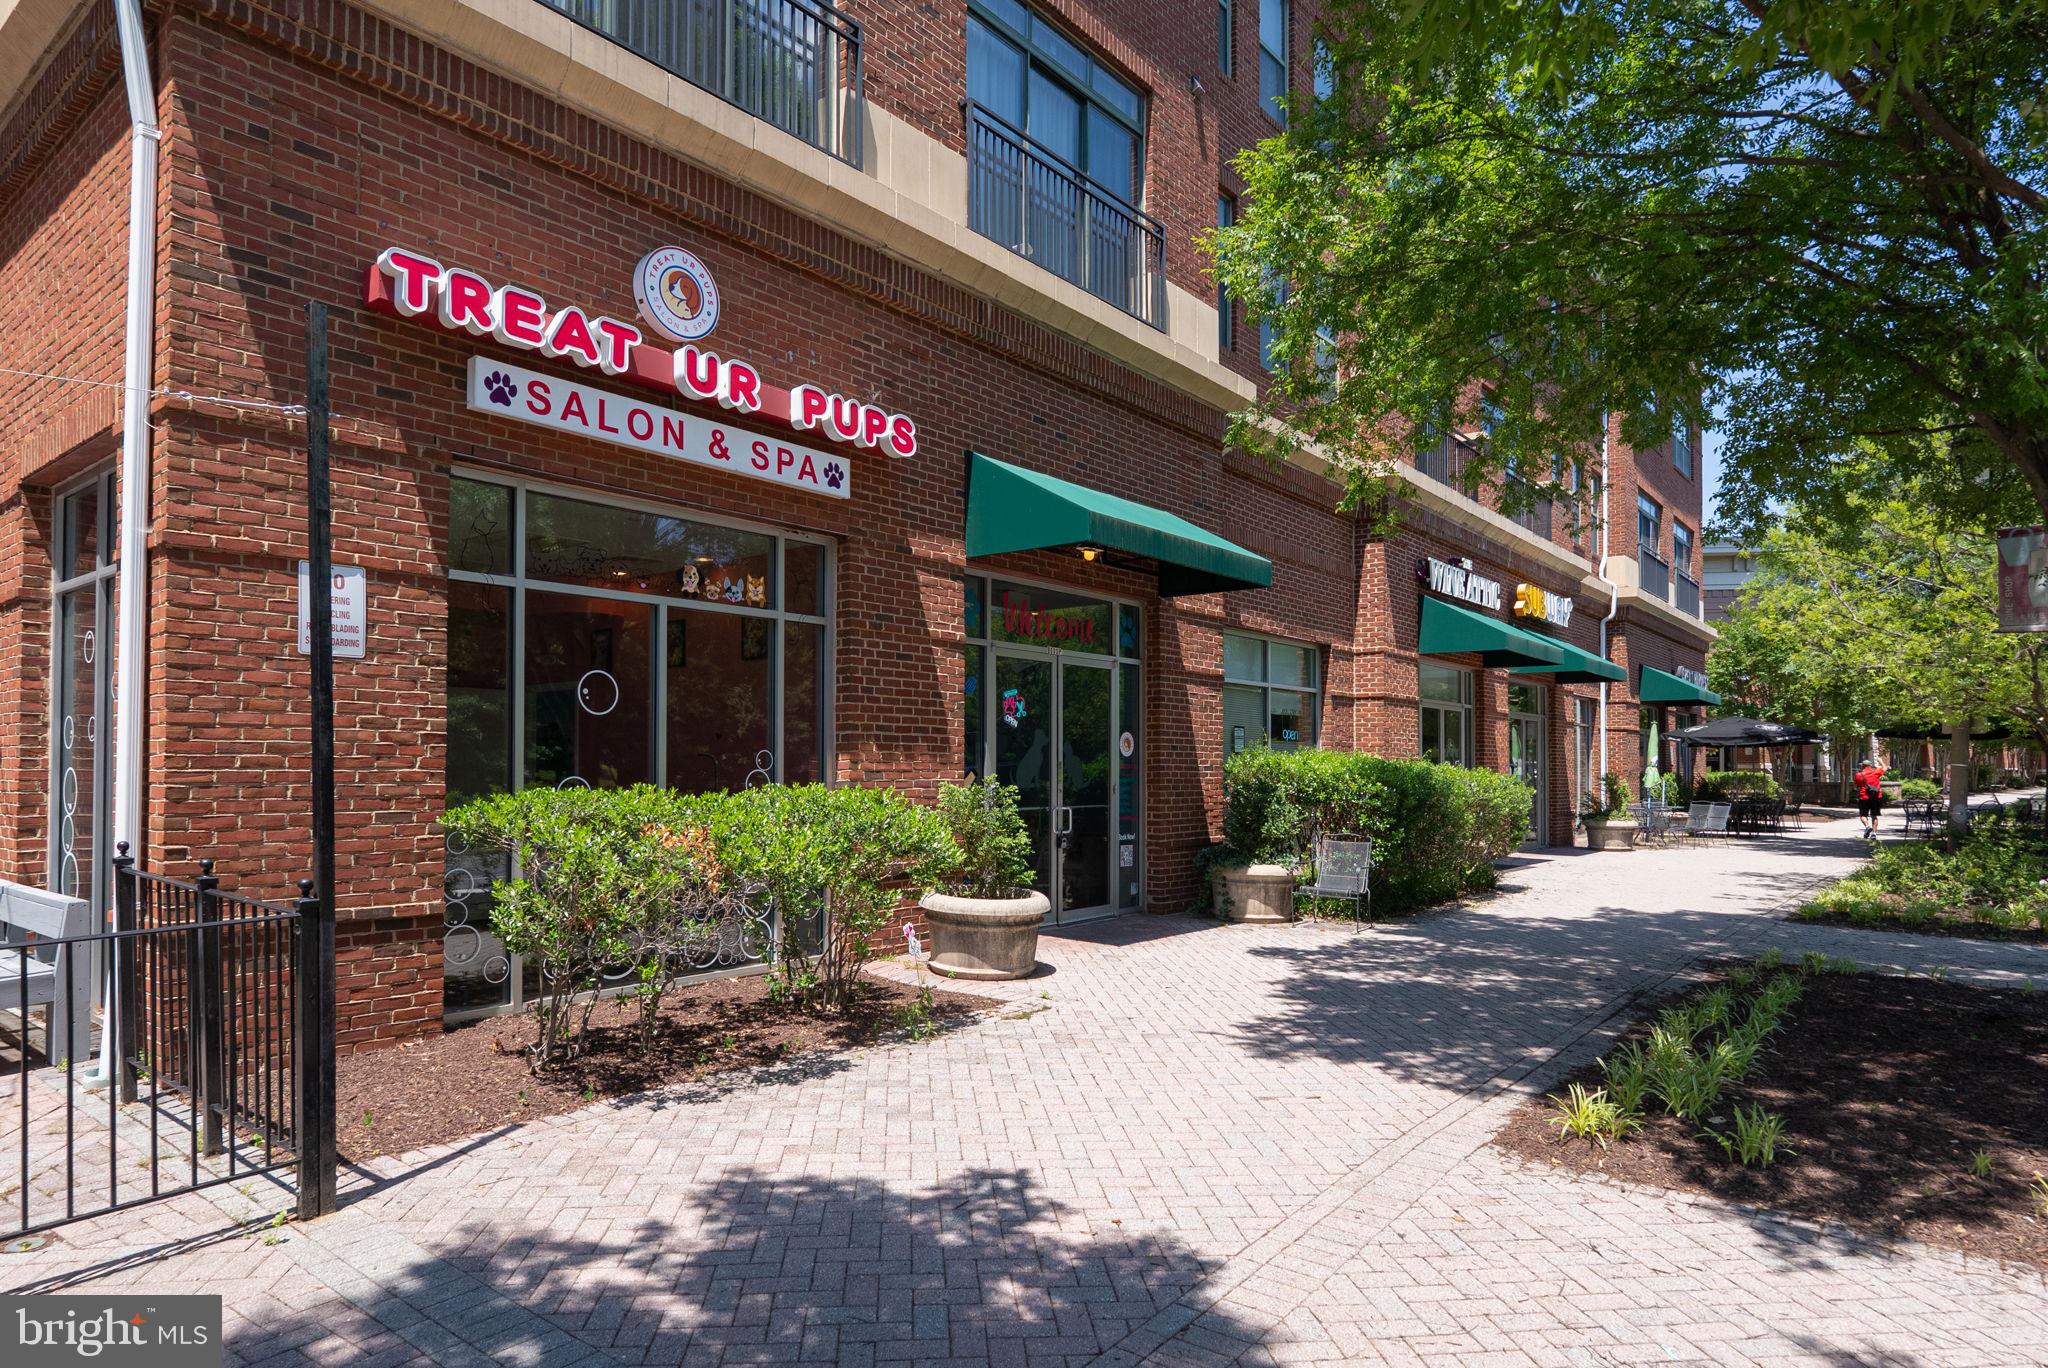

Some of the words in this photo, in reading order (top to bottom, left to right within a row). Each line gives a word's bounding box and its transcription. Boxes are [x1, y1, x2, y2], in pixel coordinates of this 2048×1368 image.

[650, 254, 674, 279] TREAT
[682, 256, 696, 270] UR
[699, 273, 714, 306] PUPS
[654, 296, 679, 330] SALON
[693, 318, 708, 331] SPA
[377, 246, 641, 375] TREAT
[674, 345, 761, 413] UR
[791, 384, 916, 458] PUPS
[526, 379, 685, 451] SALON
[708, 429, 731, 462] &
[751, 440, 819, 485] SPA
[1428, 557, 1465, 599] WINE
[1465, 572, 1501, 611] ATTIC
[1513, 583, 1573, 628] SUBWAY
